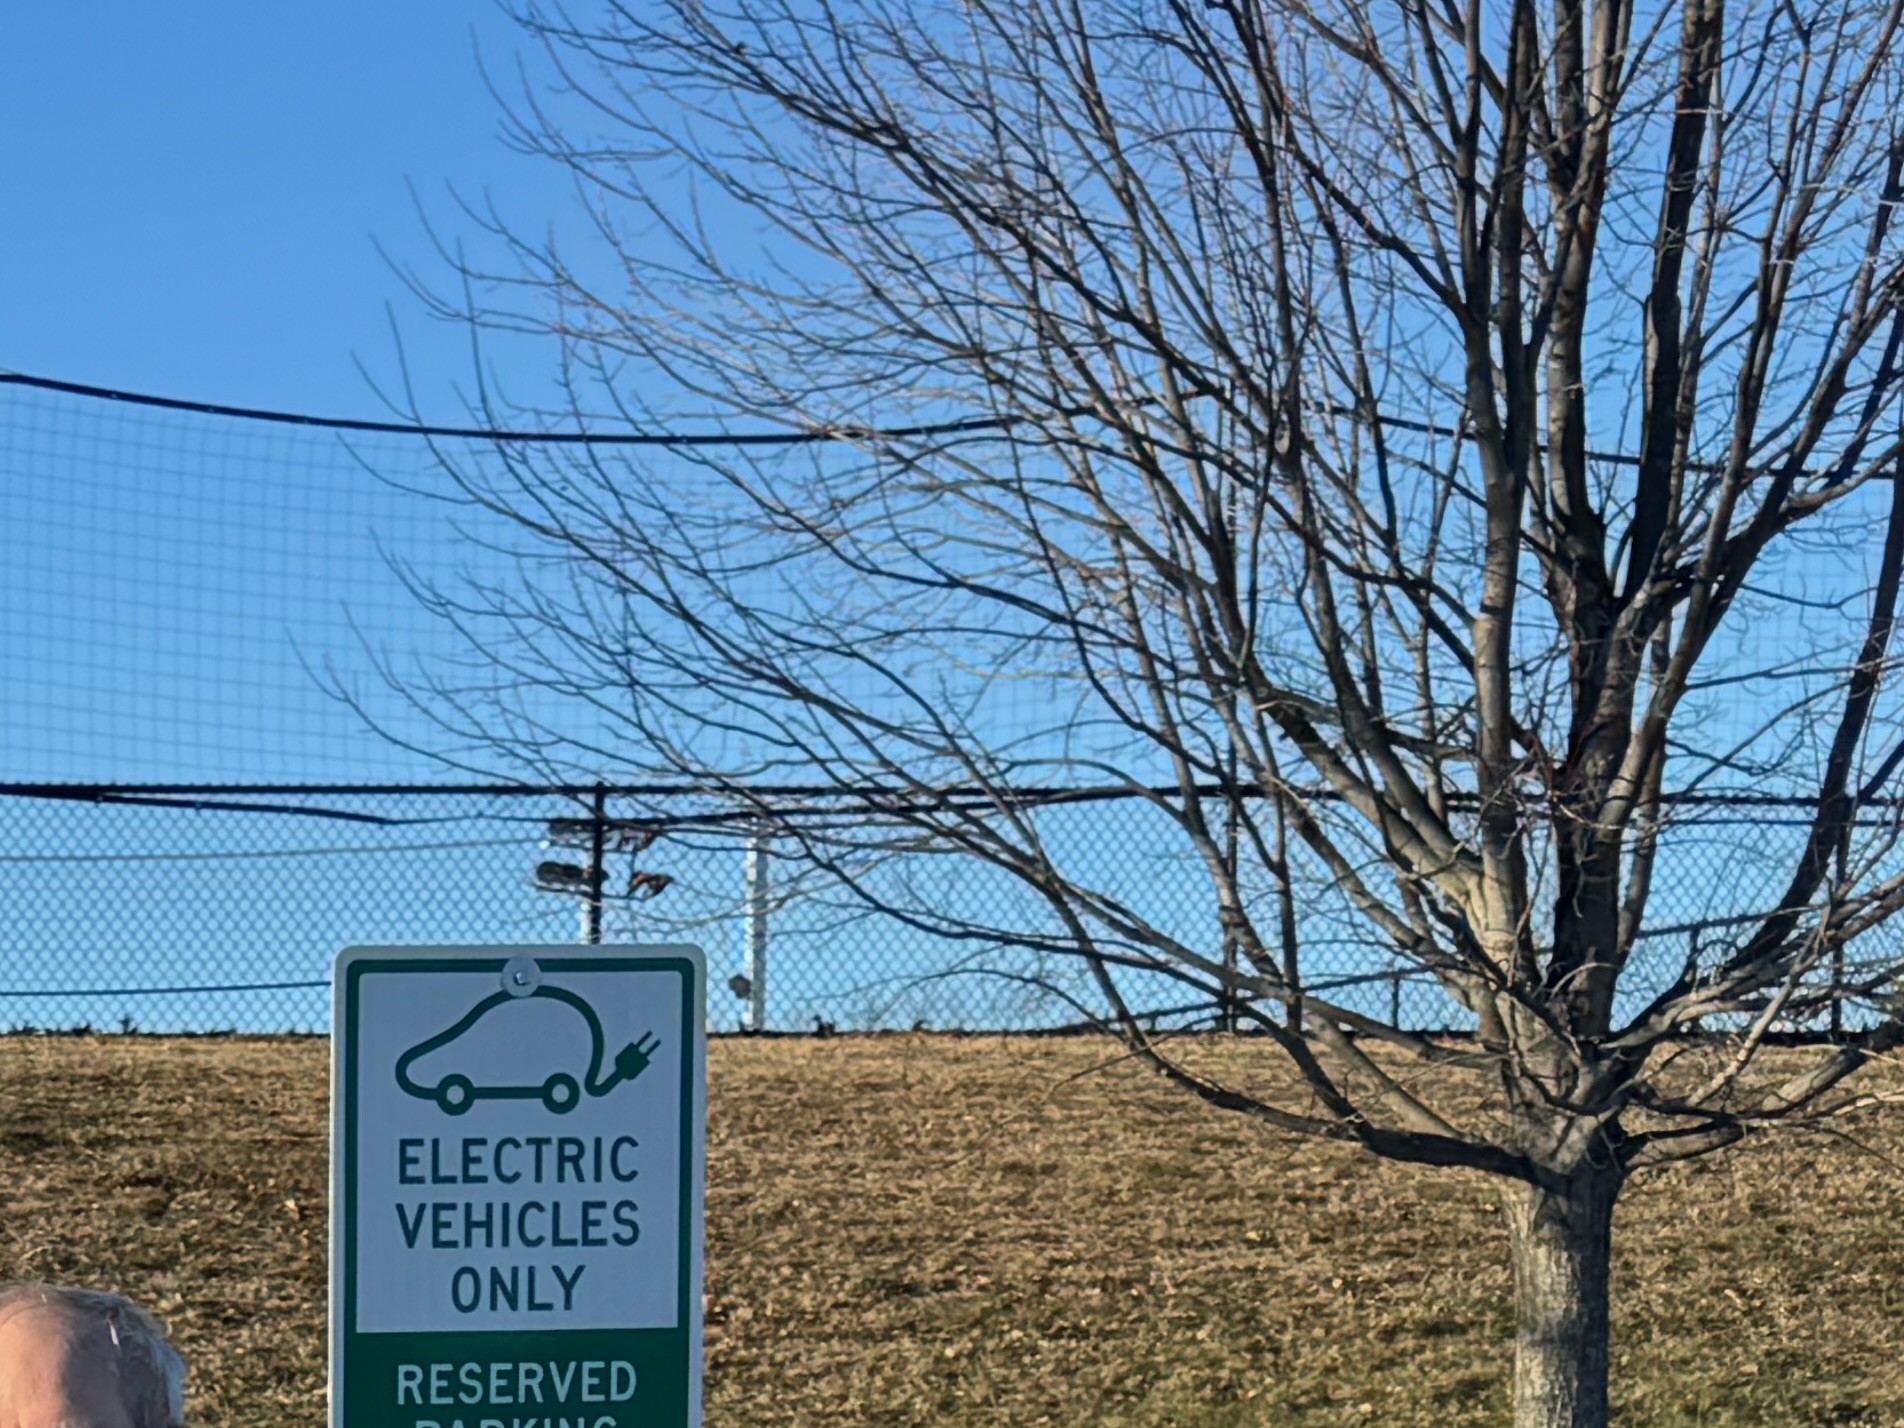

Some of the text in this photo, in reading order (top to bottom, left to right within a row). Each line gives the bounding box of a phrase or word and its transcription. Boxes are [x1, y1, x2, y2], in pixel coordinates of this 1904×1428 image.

[398, 1134, 641, 1184] ELECTRIC
[396, 1200, 640, 1248] VEHICLES
[452, 1264, 586, 1313] ONLY
[397, 1360, 637, 1405] RESERVED
